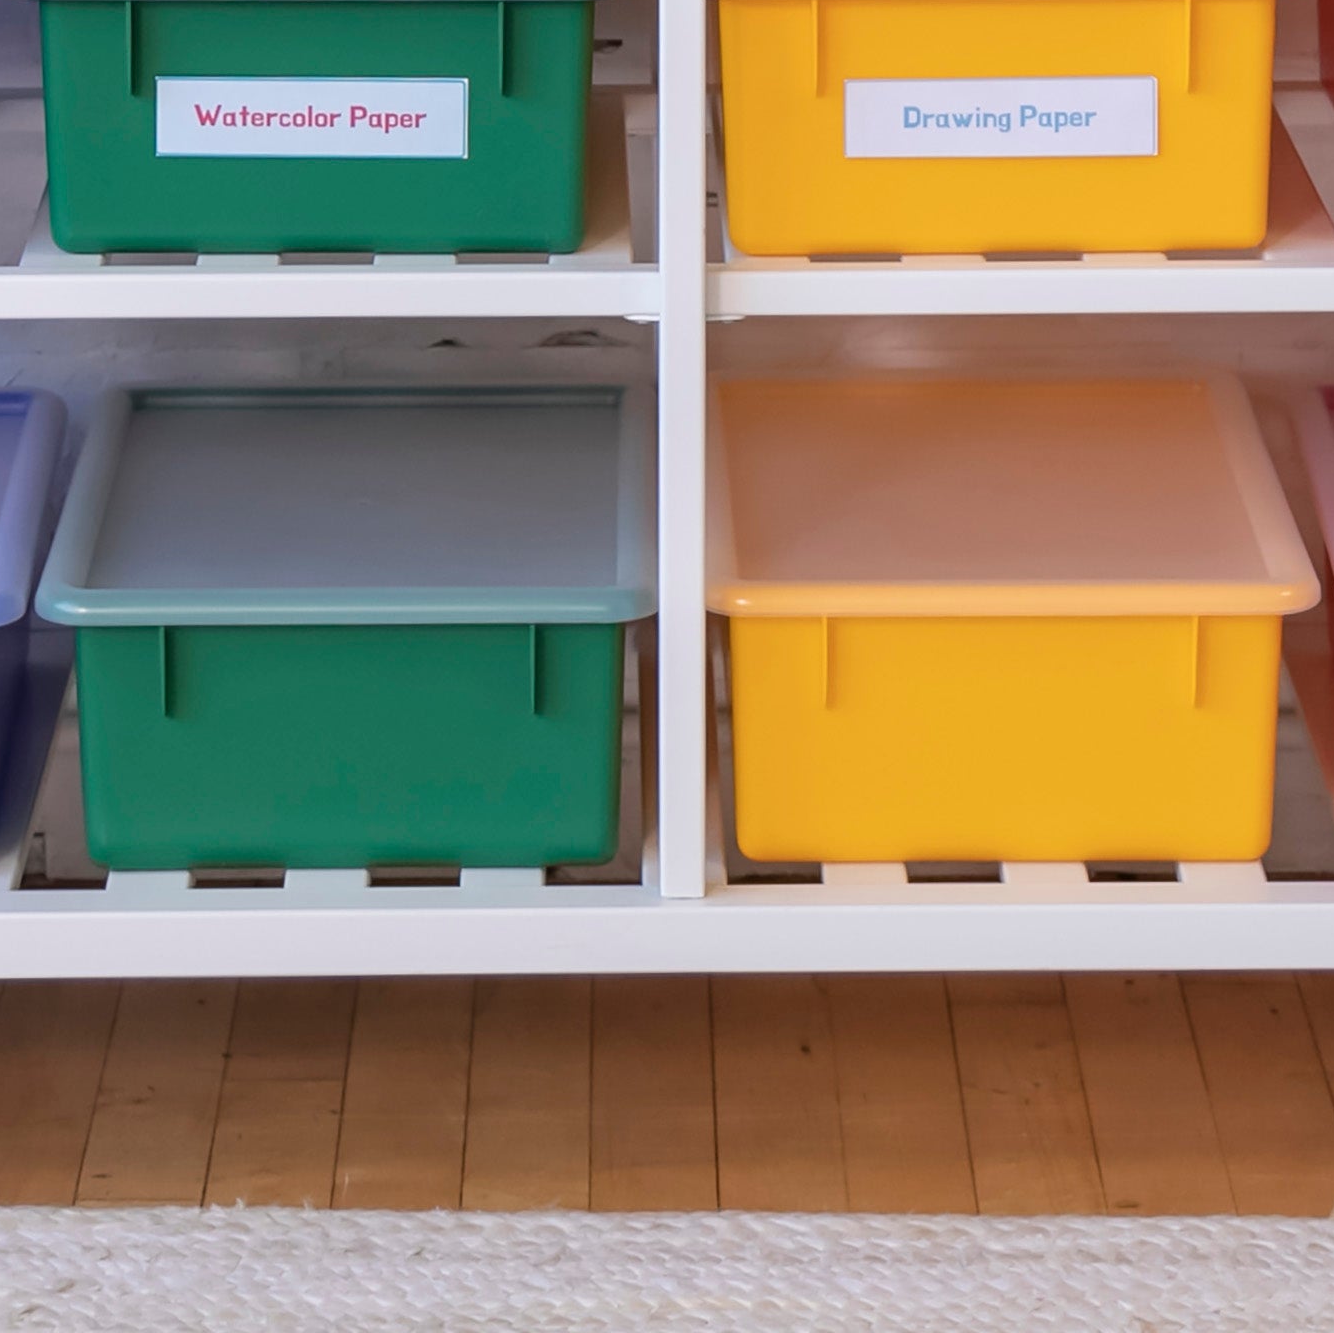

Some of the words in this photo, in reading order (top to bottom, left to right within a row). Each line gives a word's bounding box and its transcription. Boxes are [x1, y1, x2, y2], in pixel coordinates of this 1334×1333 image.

[194, 104, 341, 128] Watercolor
[350, 105, 427, 133] Paper
[903, 106, 1011, 133] Drawing
[1020, 104, 1097, 133] Paper
